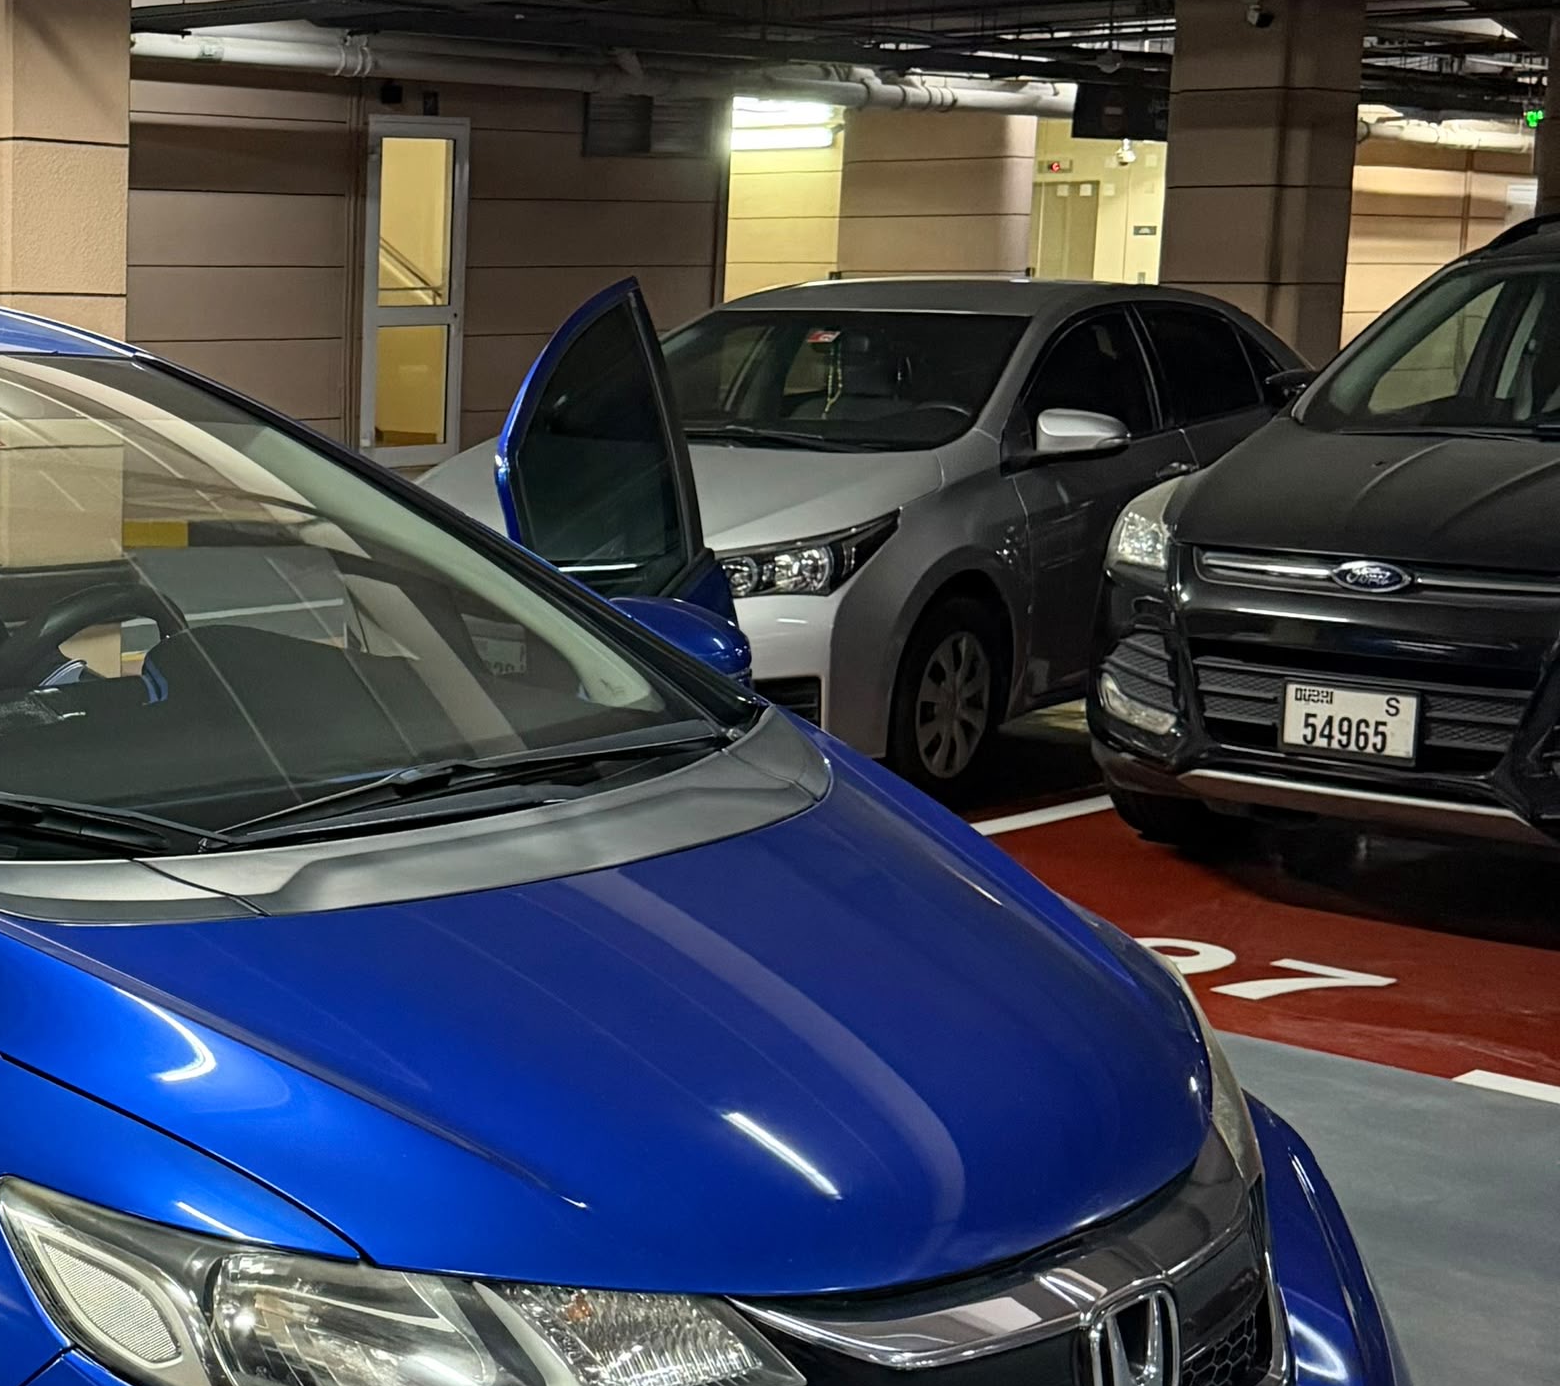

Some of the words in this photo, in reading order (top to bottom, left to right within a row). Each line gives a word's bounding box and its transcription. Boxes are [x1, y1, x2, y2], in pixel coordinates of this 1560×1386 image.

[1345, 567, 1391, 585] Ford
[1384, 696, 1400, 717] S
[1302, 712, 1388, 753] 54965
